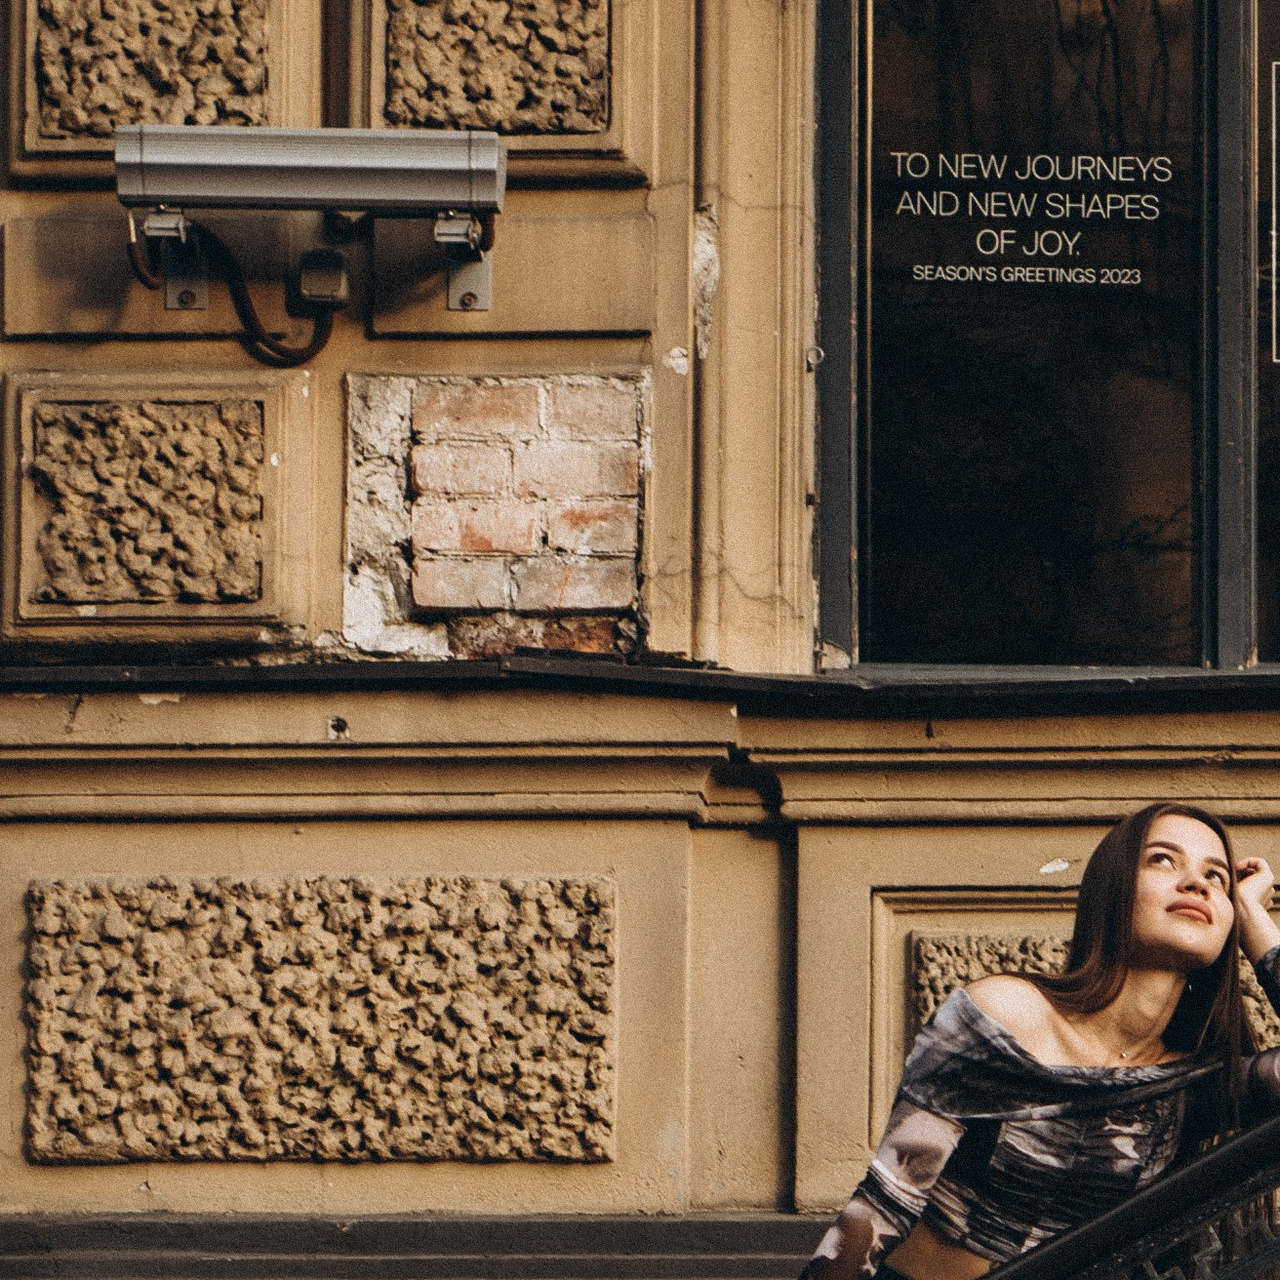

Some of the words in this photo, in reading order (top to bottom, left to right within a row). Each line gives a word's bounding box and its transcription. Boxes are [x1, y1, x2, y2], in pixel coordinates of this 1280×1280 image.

[890, 152, 929, 178] TO
[939, 153, 1007, 178] NEW
[1015, 155, 1172, 182] JOURNEYS
[896, 191, 959, 216] AND
[968, 192, 1037, 217] NEW
[1046, 193, 1159, 220] SHAPES
[976, 229, 1016, 255] OF
[1022, 230, 1081, 256] JOY.
[913, 265, 997, 281] SEASON'S
[1001, 267, 1096, 283] GREETINGS
[1100, 269, 1141, 284] 2023
